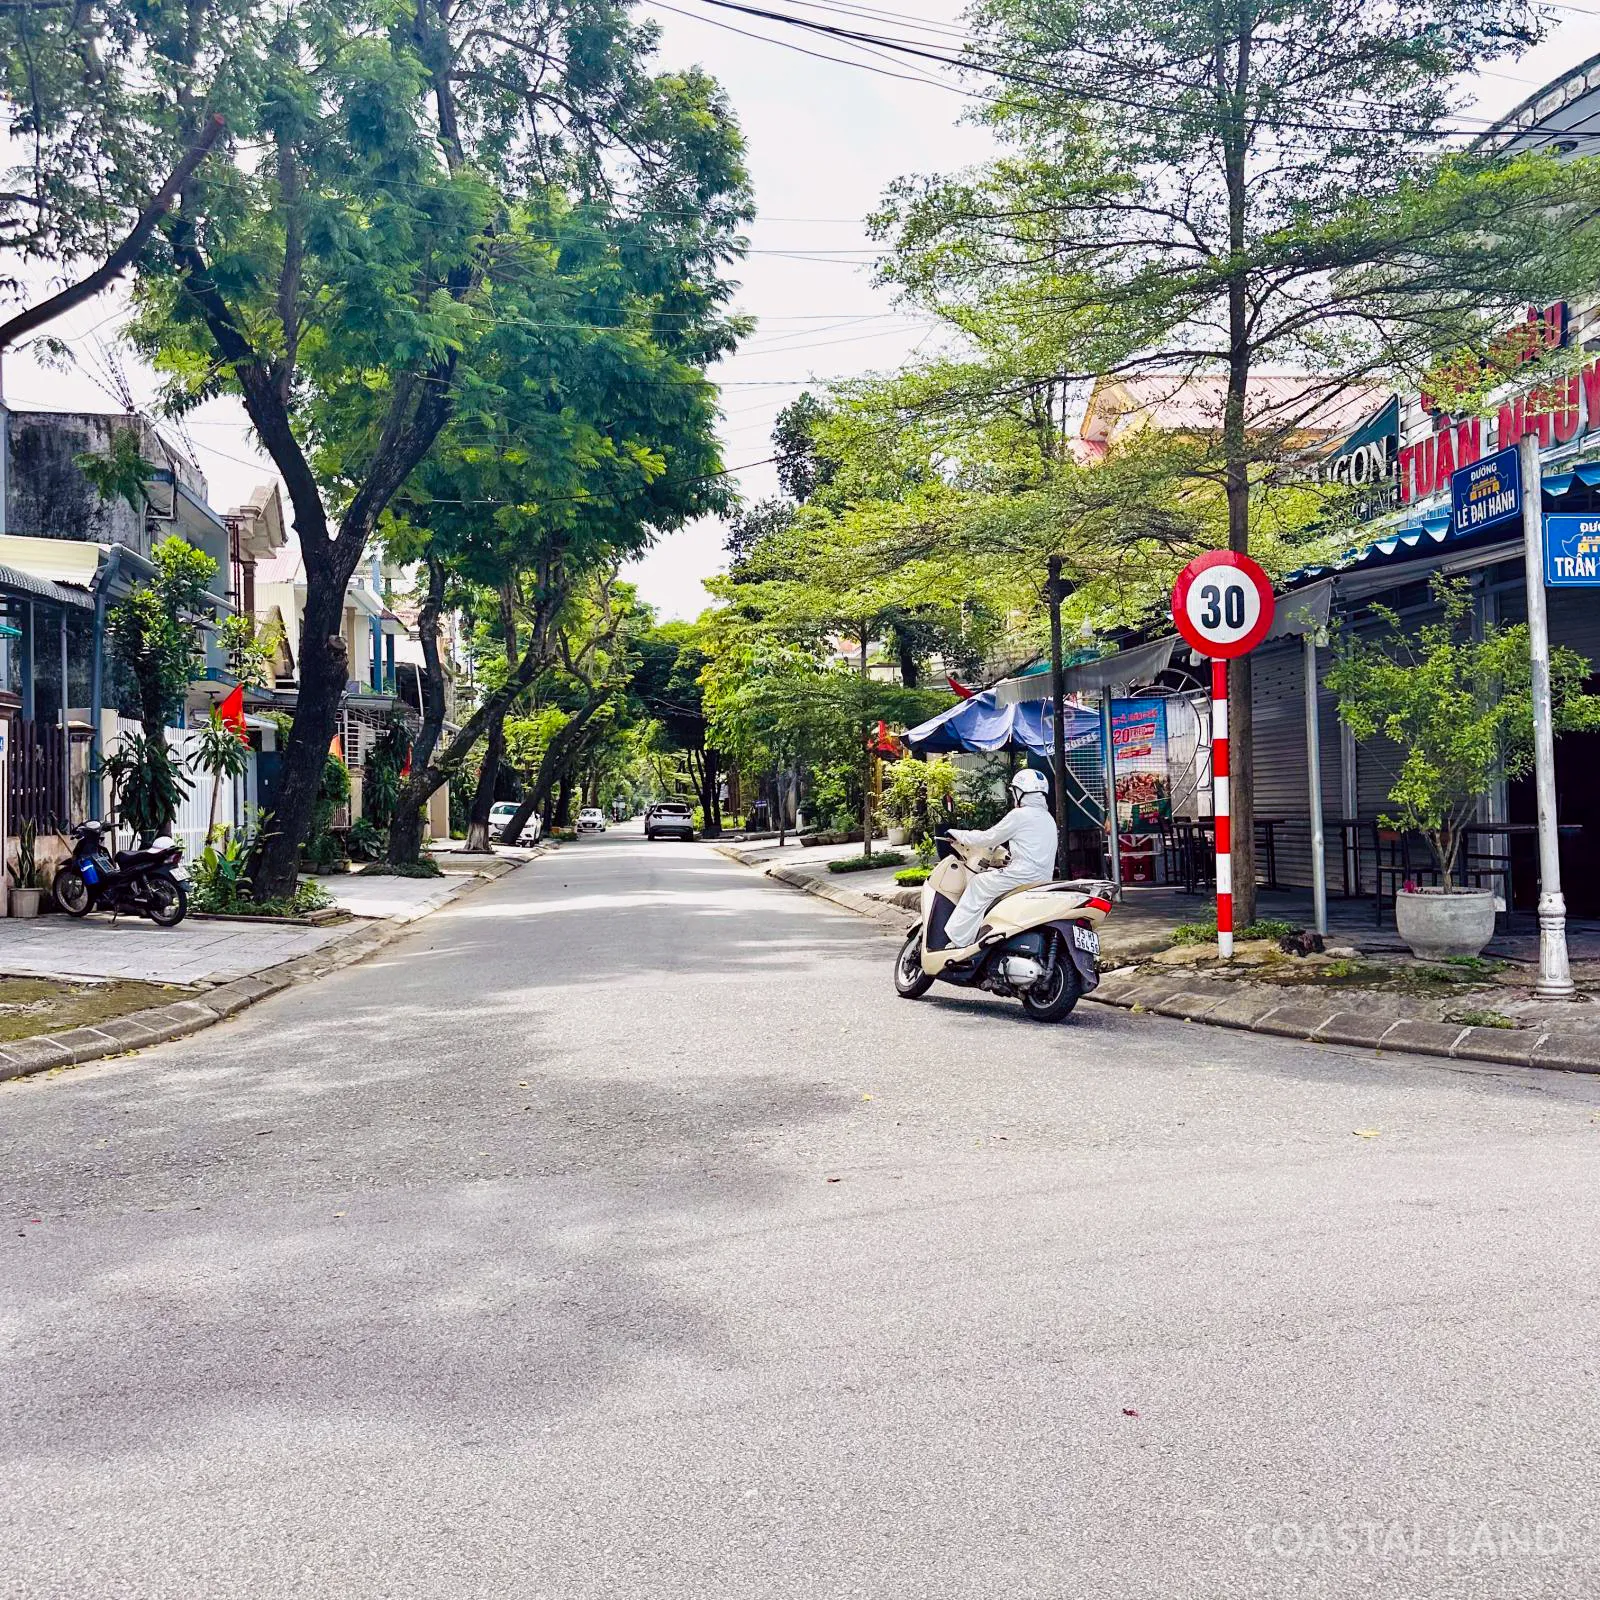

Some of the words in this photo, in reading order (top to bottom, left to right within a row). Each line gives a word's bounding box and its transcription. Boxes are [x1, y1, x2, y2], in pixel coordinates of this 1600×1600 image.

[1457, 504, 1469, 529] LÊ
[1471, 501, 1487, 525] ĐẠI
[1488, 489, 1516, 517] HÀNH
[1579, 521, 1600, 533] ĐƯ
[1200, 584, 1245, 629] 30
[1113, 728, 1130, 745] 20
